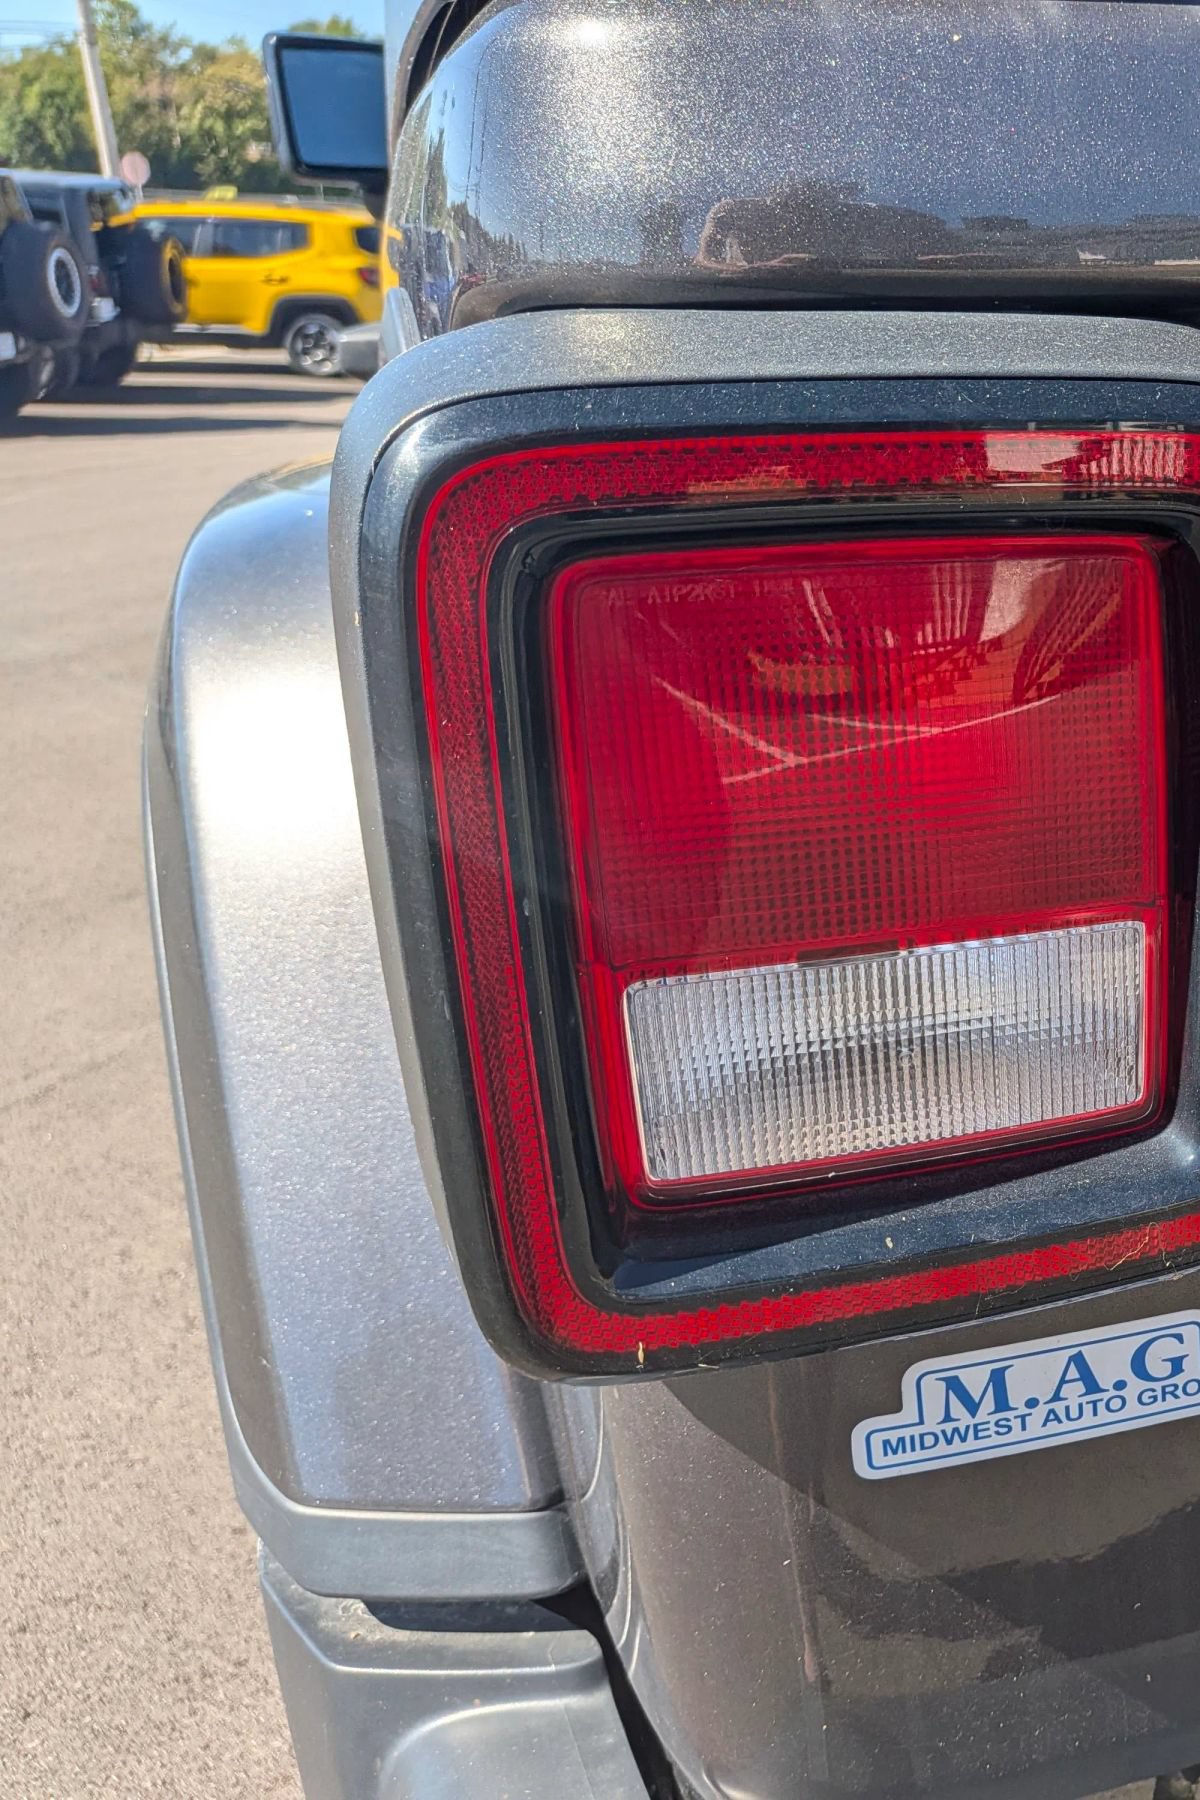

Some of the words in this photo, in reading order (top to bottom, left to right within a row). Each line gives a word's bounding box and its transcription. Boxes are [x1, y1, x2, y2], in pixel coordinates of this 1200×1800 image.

[935, 1332, 1190, 1426] M.A.G
[882, 1412, 1034, 1457] MIDWEST
[1040, 1394, 1127, 1428] AUTO
